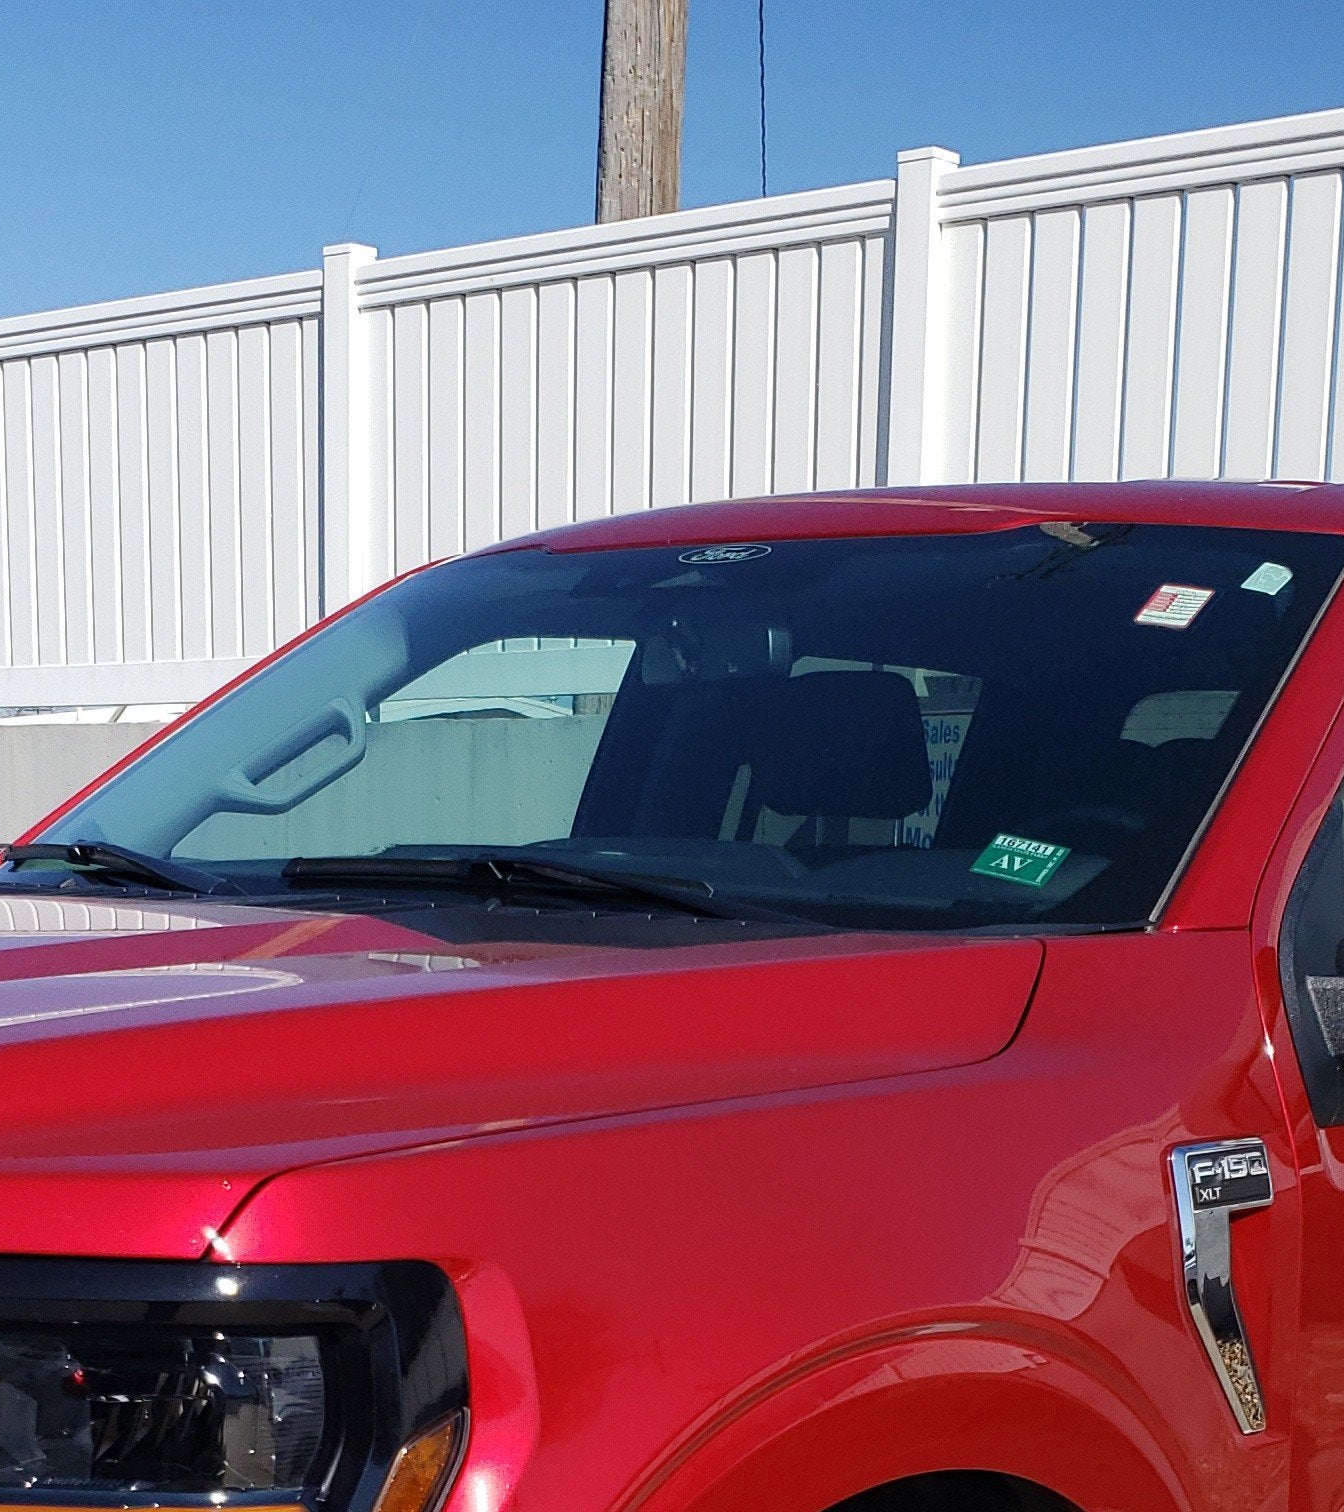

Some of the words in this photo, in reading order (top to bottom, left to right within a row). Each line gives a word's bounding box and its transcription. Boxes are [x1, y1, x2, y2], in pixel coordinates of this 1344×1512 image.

[690, 547, 758, 561] Ford
[989, 854, 1034, 872] AV
[1192, 1151, 1268, 1184] F-150
[1199, 1187, 1222, 1202] XLT
